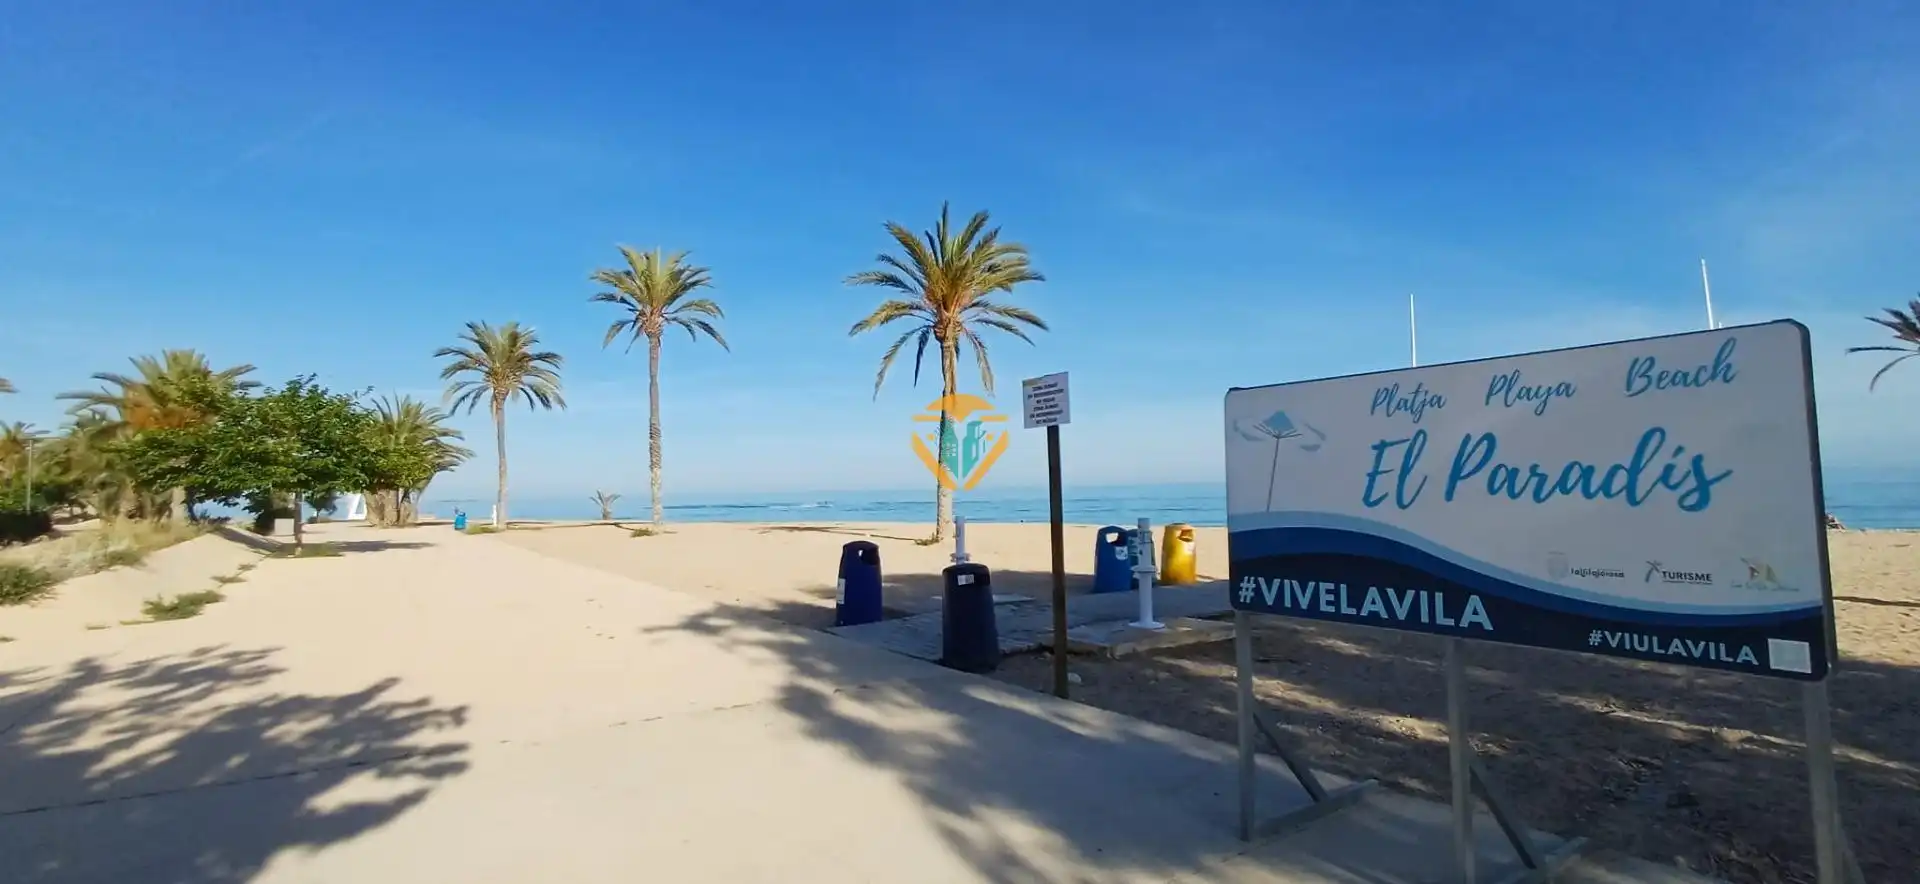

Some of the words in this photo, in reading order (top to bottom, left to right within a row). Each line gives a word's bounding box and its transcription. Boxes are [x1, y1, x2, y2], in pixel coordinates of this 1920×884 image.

[1370, 382, 1446, 423] Platja
[1484, 368, 1577, 416] Playa
[1625, 337, 1739, 398] Beach
[1362, 429, 1428, 510] El
[1444, 426, 1734, 512] Paradís
[1238, 575, 1494, 631] #VIVELAVILA
[1662, 571, 1713, 582] TURISME
[1587, 629, 1759, 666] #VIULAVILA
